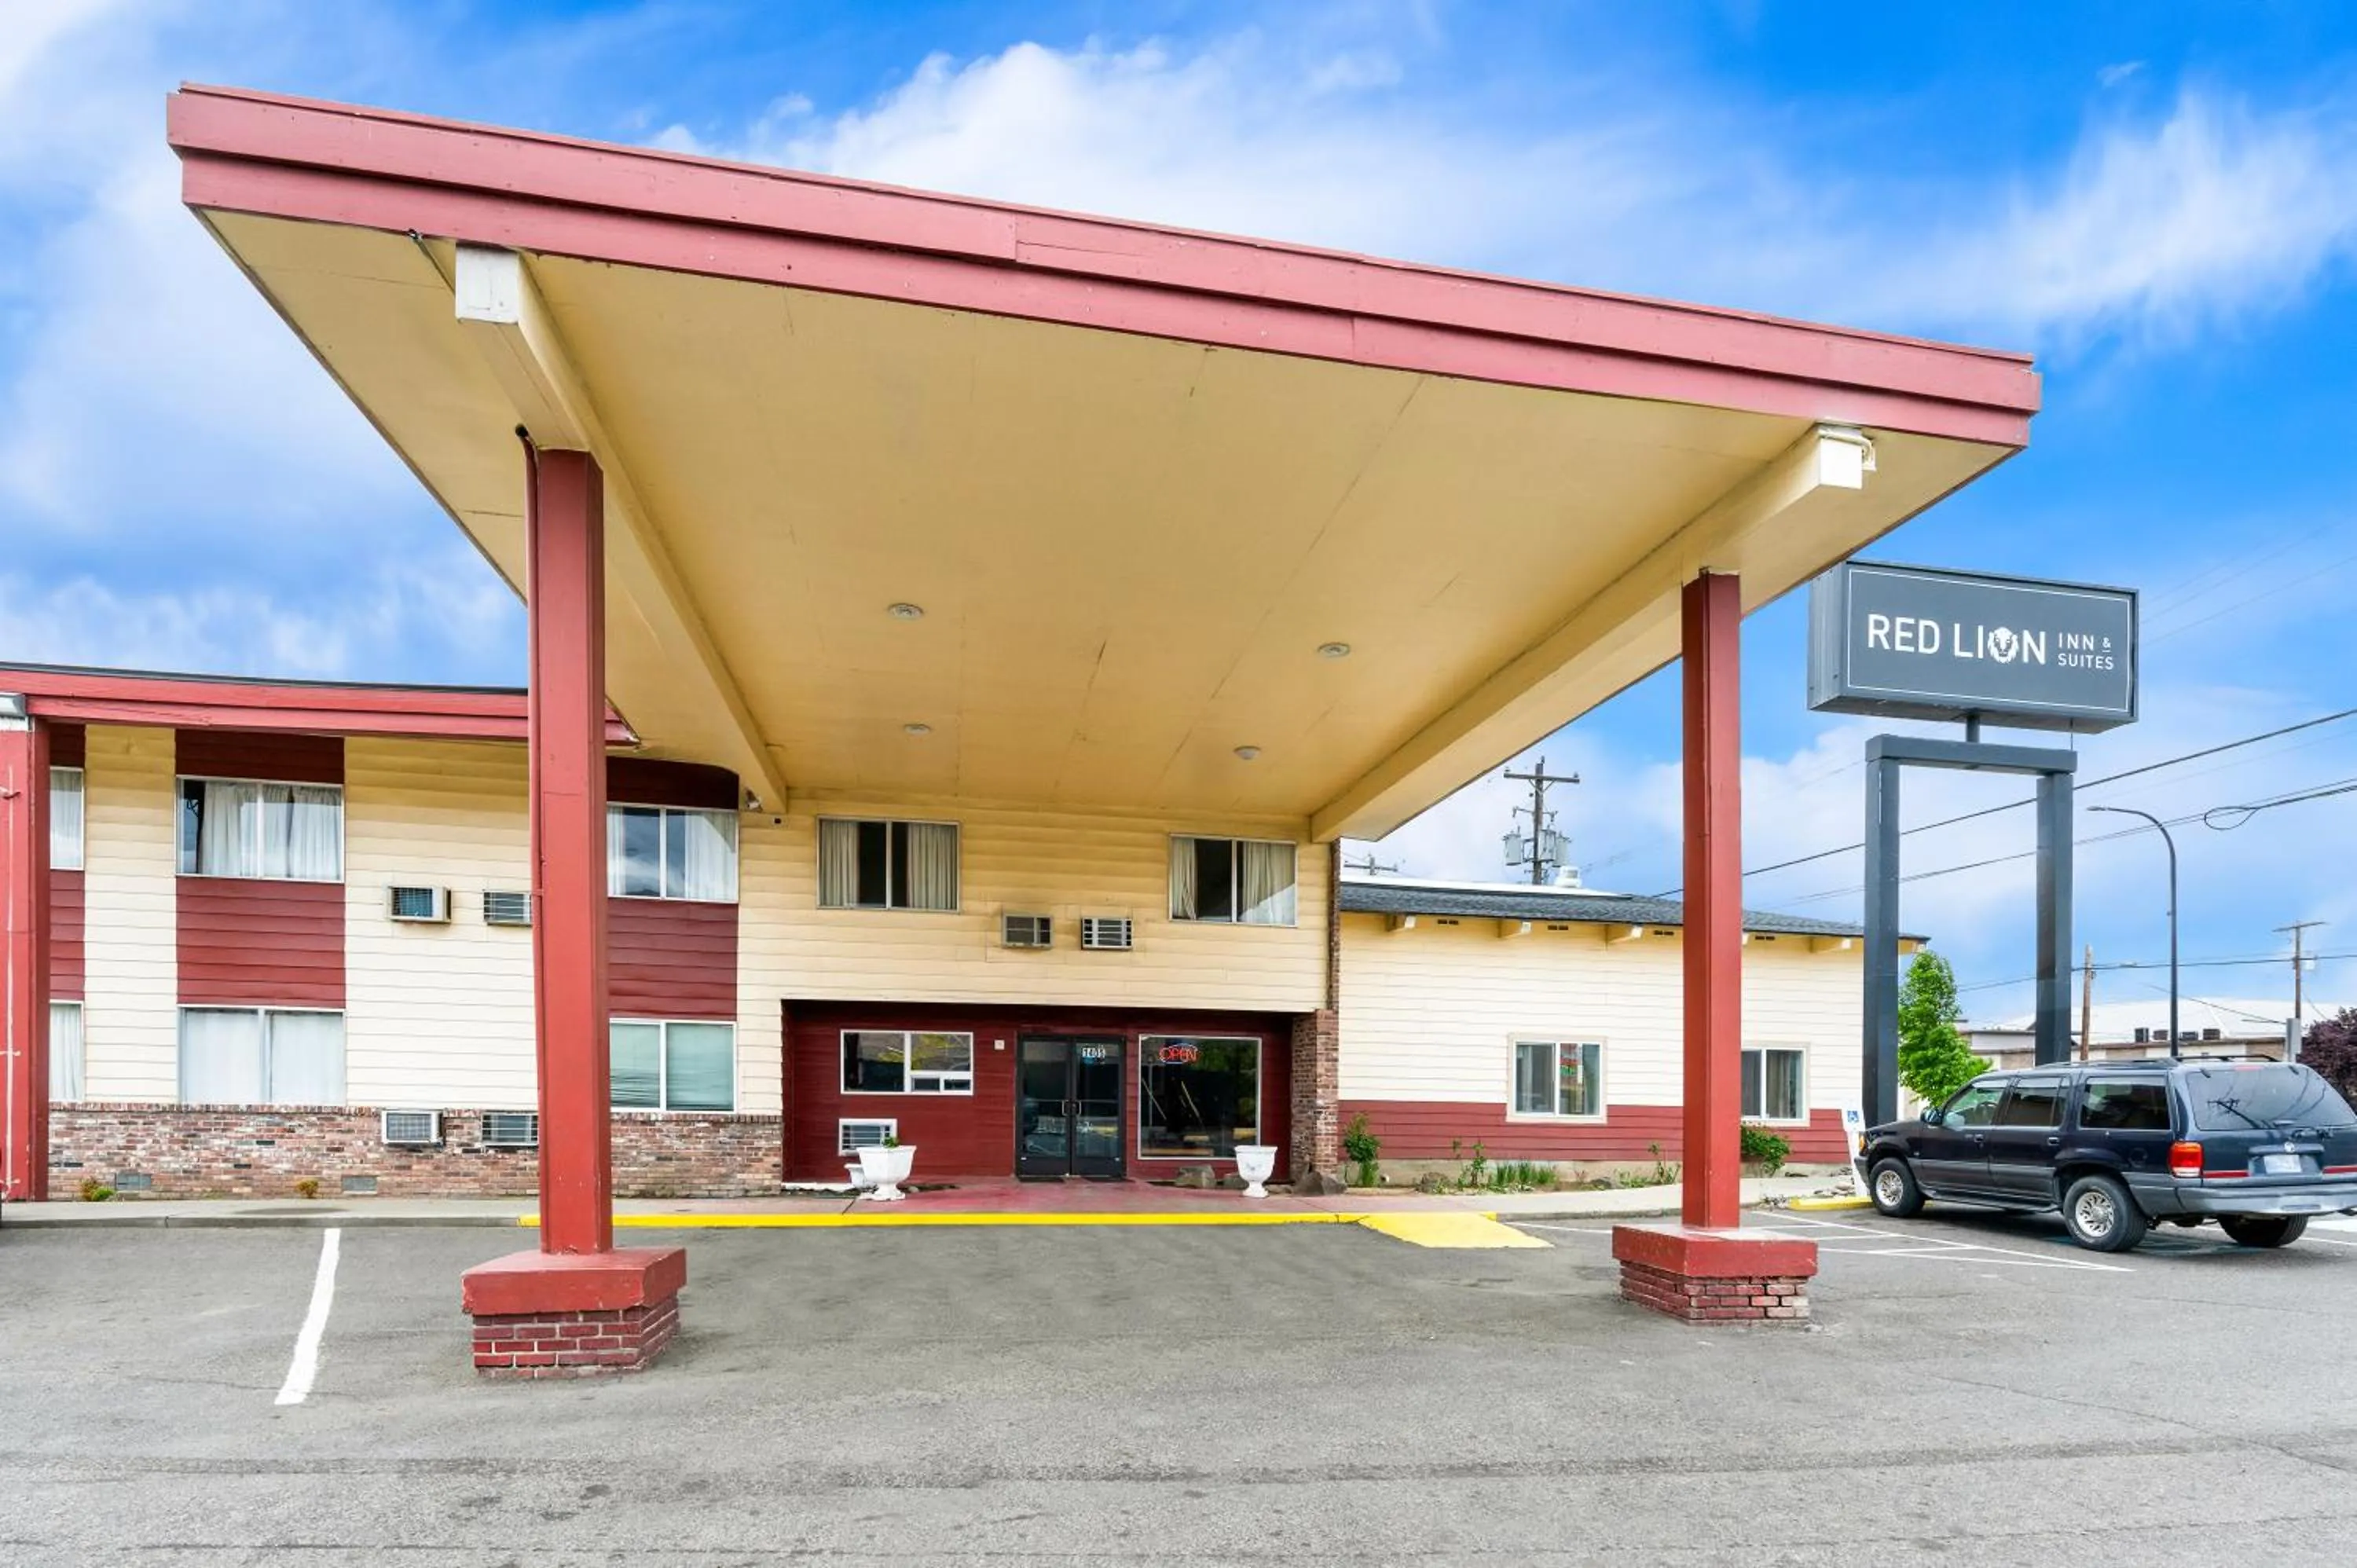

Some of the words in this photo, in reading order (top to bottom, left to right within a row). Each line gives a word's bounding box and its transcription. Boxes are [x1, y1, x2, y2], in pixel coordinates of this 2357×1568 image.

[1868, 614, 1941, 654] RED
[1954, 623, 2046, 665] LION
[2058, 632, 2095, 651] INN
[2102, 637, 2111, 649] &
[2058, 653, 2114, 670] SUITES
[1159, 1046, 1197, 1061] OPEN
